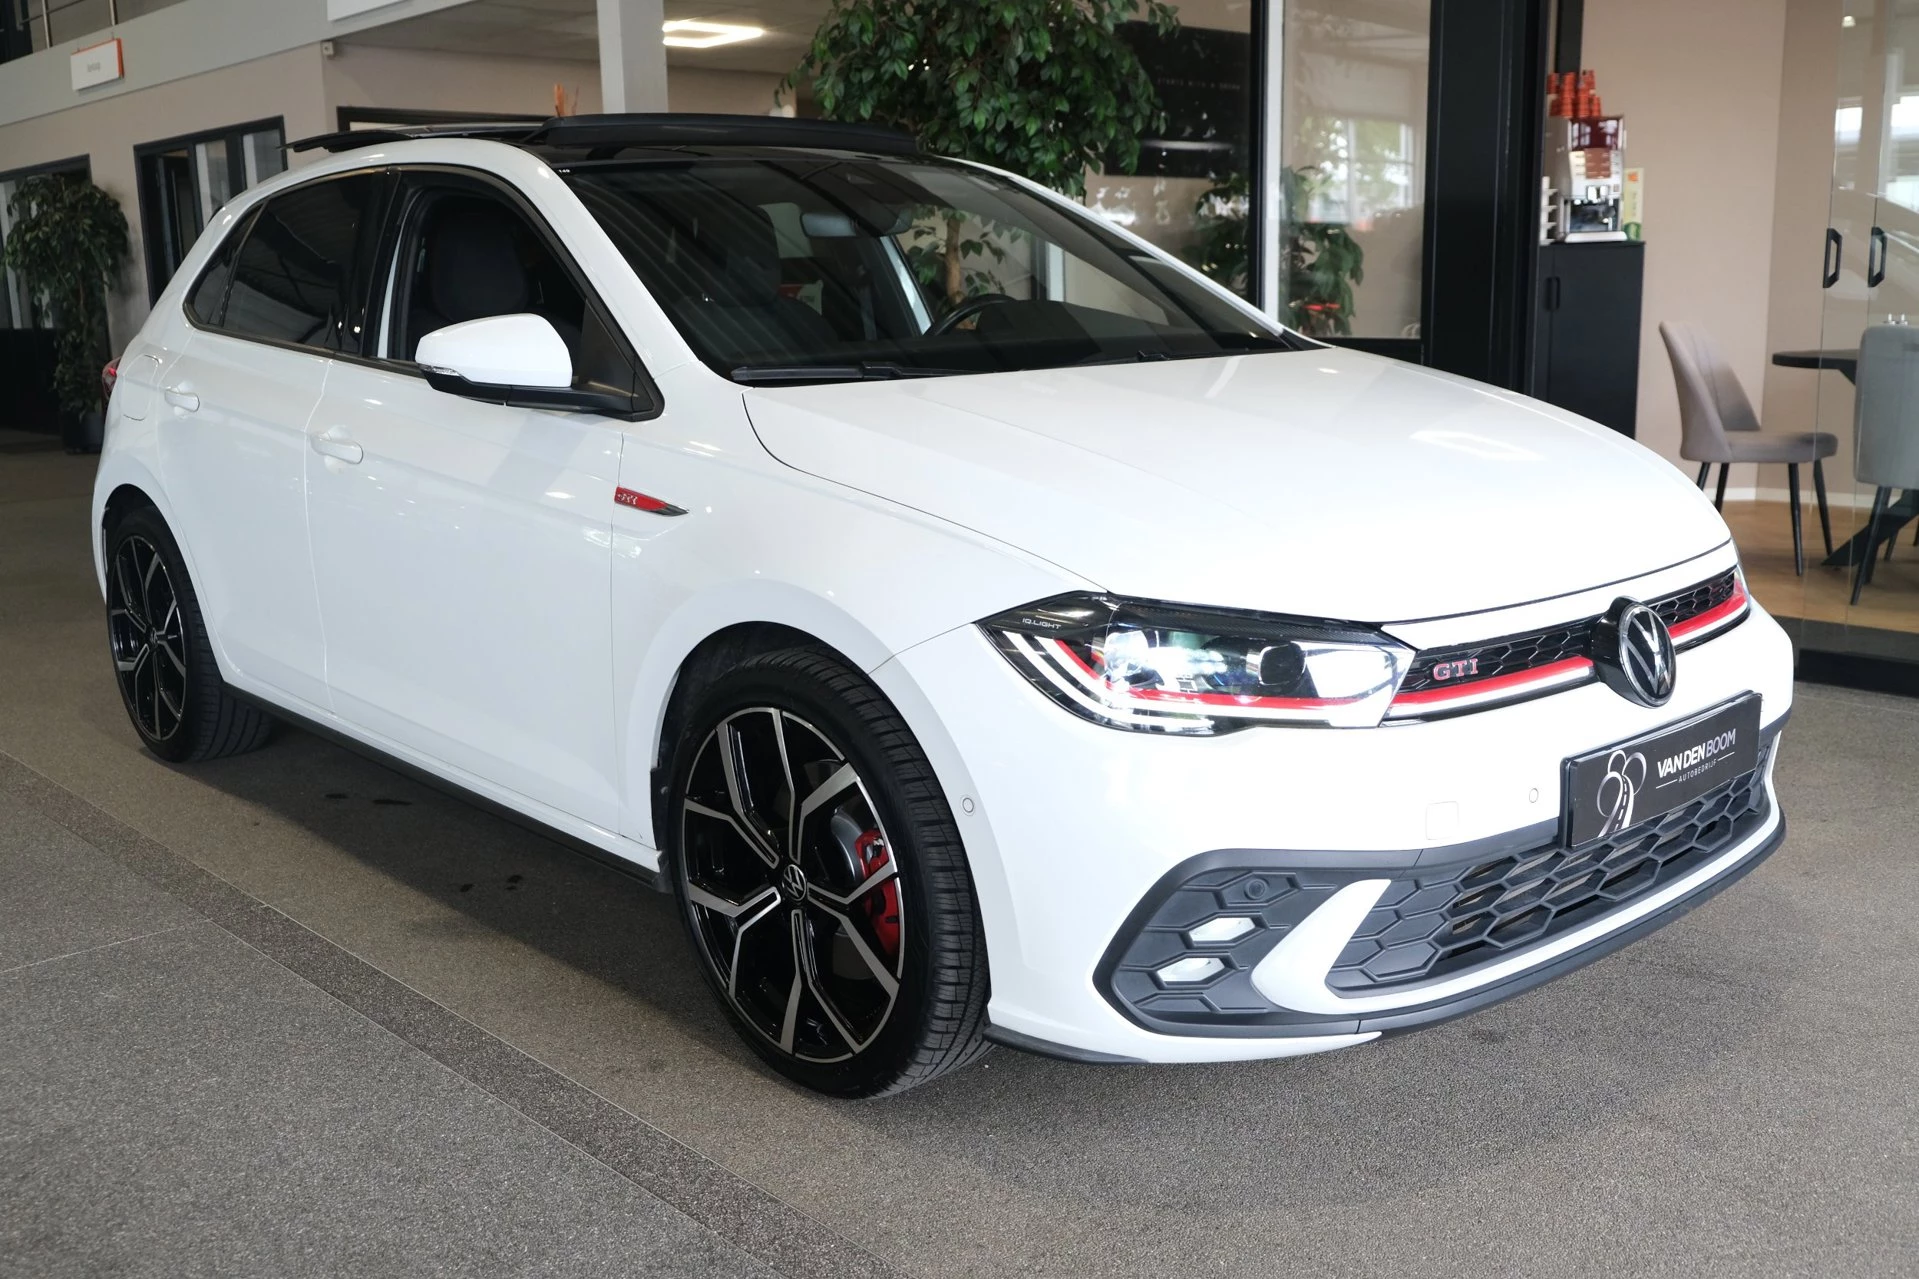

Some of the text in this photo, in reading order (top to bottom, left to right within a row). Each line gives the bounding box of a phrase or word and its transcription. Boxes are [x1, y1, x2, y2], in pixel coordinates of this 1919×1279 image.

[1022, 617, 1061, 629] IQ.LIGHT
[1433, 658, 1479, 681] GTI
[1706, 728, 1736, 758] BOOM
[1678, 758, 1716, 783] AUTOBEDRIJF
